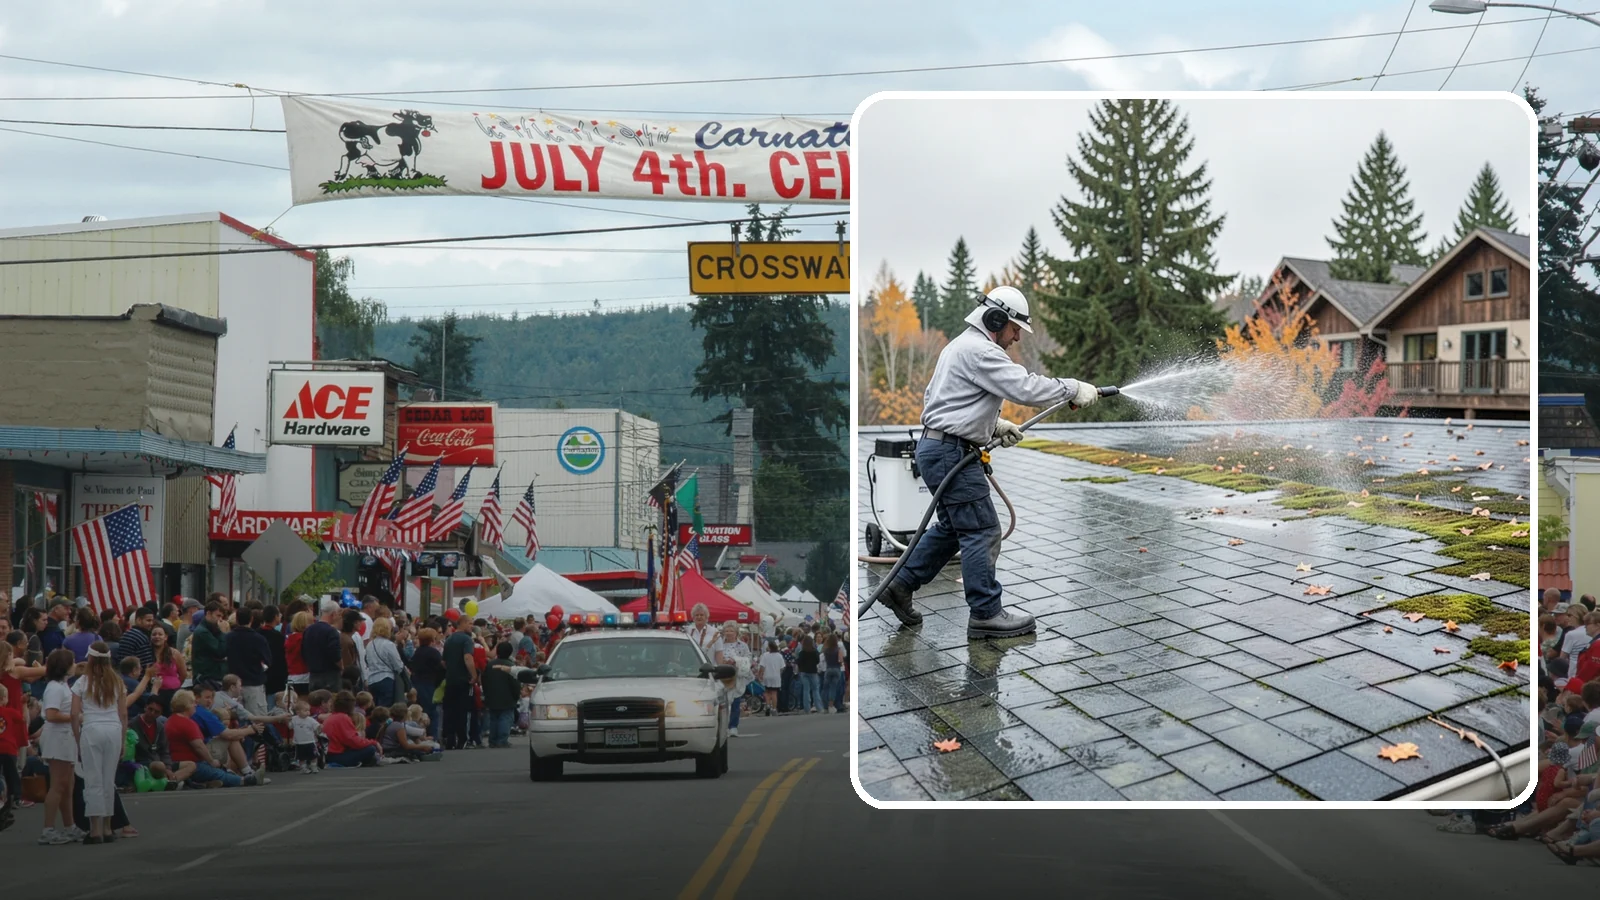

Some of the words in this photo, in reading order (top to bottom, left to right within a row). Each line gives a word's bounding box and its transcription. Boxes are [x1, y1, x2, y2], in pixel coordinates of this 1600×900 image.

[481, 141, 605, 192] JULY
[632, 149, 746, 198] 4th.
[697, 254, 850, 280] CROSSWA
[283, 380, 373, 420] ACE
[405, 409, 453, 421] CEDAR
[461, 409, 485, 421] LOG
[283, 421, 370, 436] Hardware
[416, 428, 477, 447] Coca-Cola
[353, 466, 385, 482] Simpl
[95, 485, 124, 495] Vincent
[126, 486, 135, 494] de
[137, 486, 155, 495] Paul
[212, 516, 330, 535] HARDARE
[688, 526, 741, 535] CRNATION
[699, 535, 730, 543] GLASS
